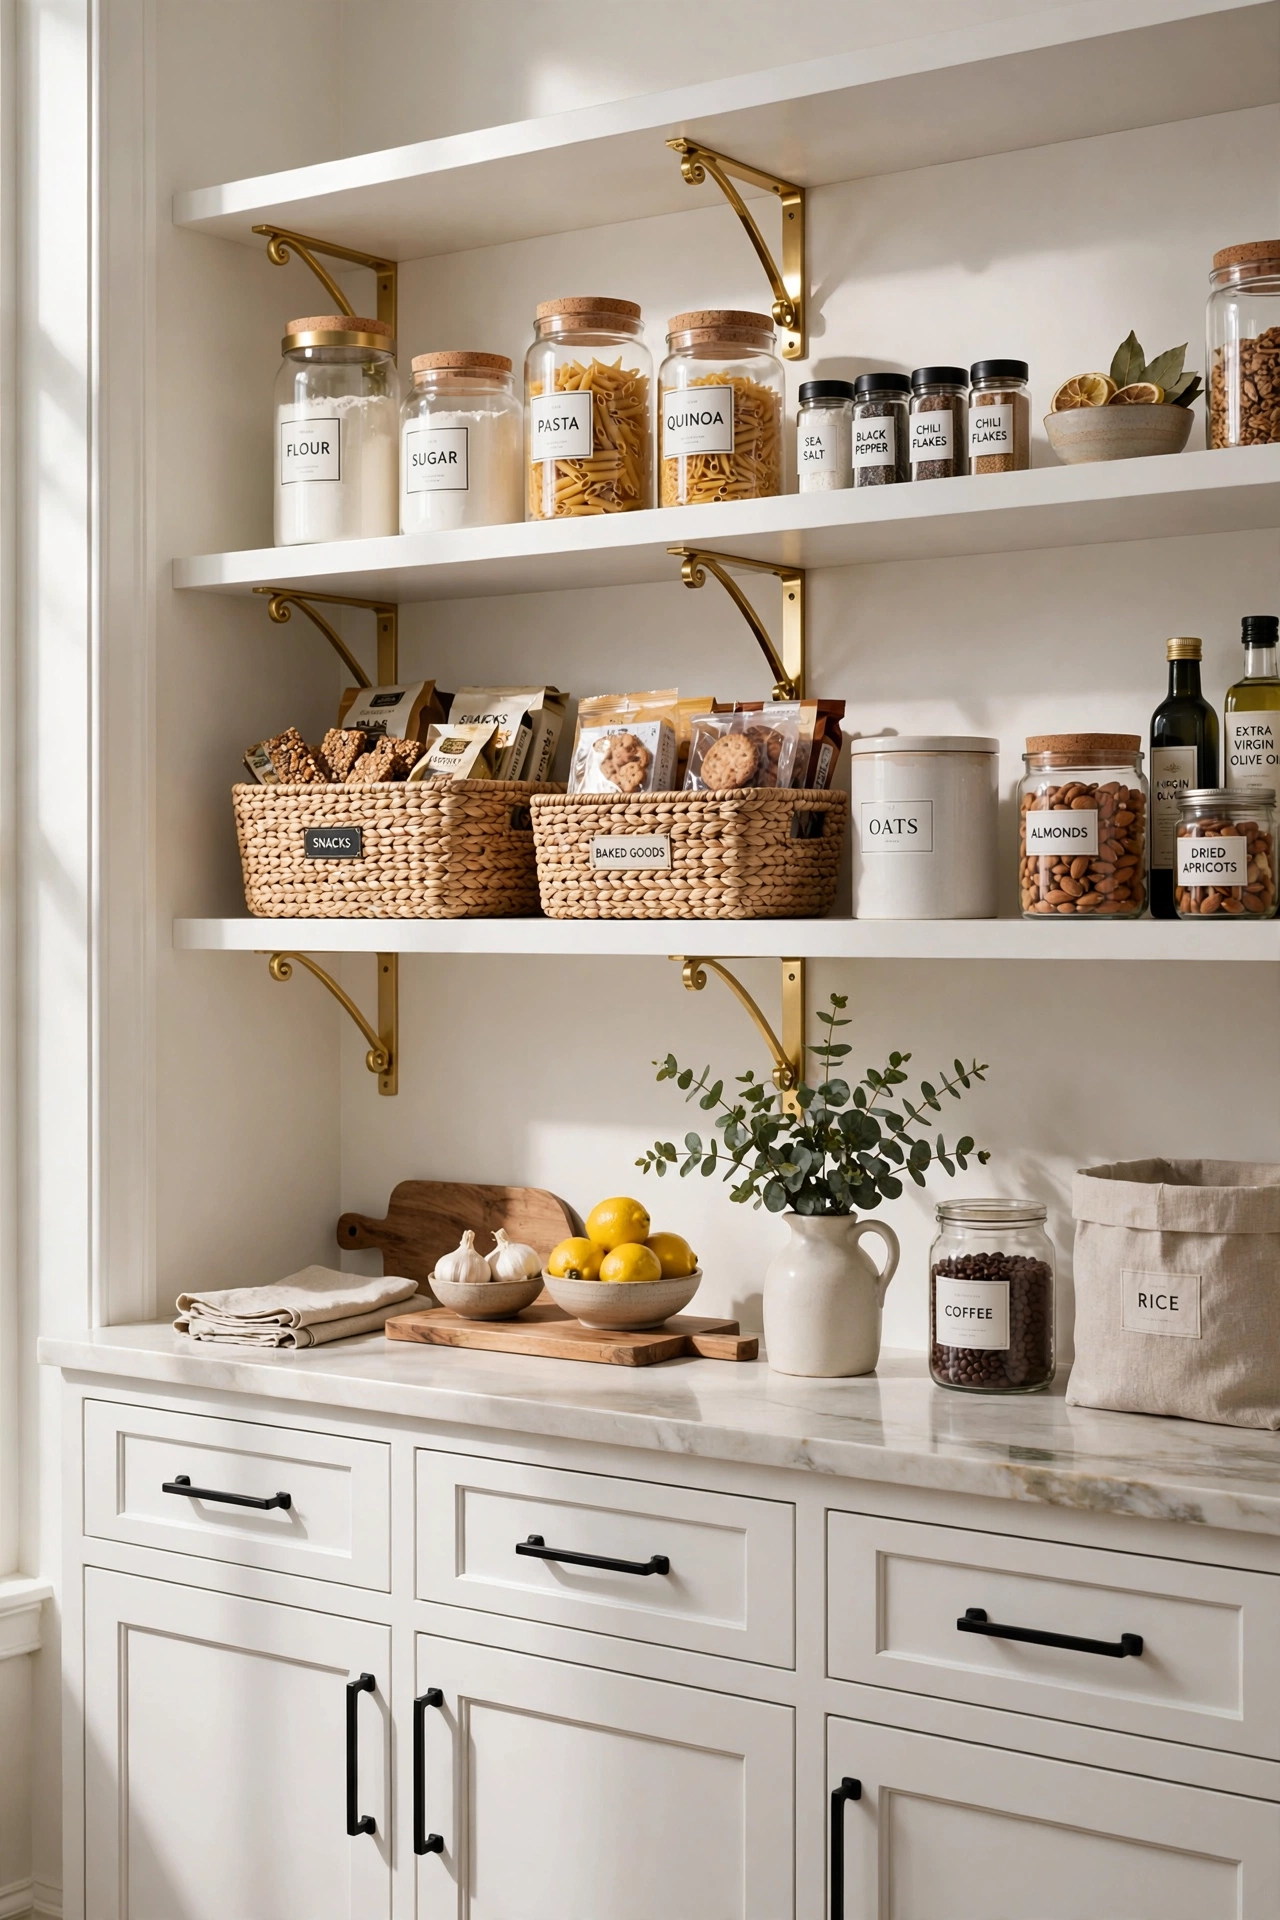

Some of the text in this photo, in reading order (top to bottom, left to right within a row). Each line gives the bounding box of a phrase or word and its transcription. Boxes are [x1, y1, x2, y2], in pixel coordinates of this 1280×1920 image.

[538, 417, 579, 433] PASTA
[667, 411, 724, 430] QUINOA
[975, 417, 1001, 429] CHILI
[856, 429, 886, 442] BLACK
[916, 424, 941, 435] CHILI
[804, 436, 822, 447] SEA
[912, 436, 947, 449] FLAKES
[972, 430, 1007, 443] FLAKES
[287, 441, 330, 457] FLOUR
[803, 449, 825, 460] SALT
[855, 442, 888, 455] PEPPER
[412, 451, 457, 467] SUGAR
[1236, 725, 1273, 736] EXTRA
[1234, 739, 1274, 750] VIRGIN
[1230, 754, 1280, 766] OLIVE OI
[869, 818, 918, 835] OATS
[1031, 827, 1088, 839] ALMONDS
[313, 837, 351, 849] SNACKS
[595, 847, 665, 859] BAKED GOODS
[1191, 847, 1226, 859] DRIED
[1183, 862, 1237, 874] APRICOTS
[1138, 1293, 1180, 1311] RICE
[945, 1305, 993, 1320] COFFEE
